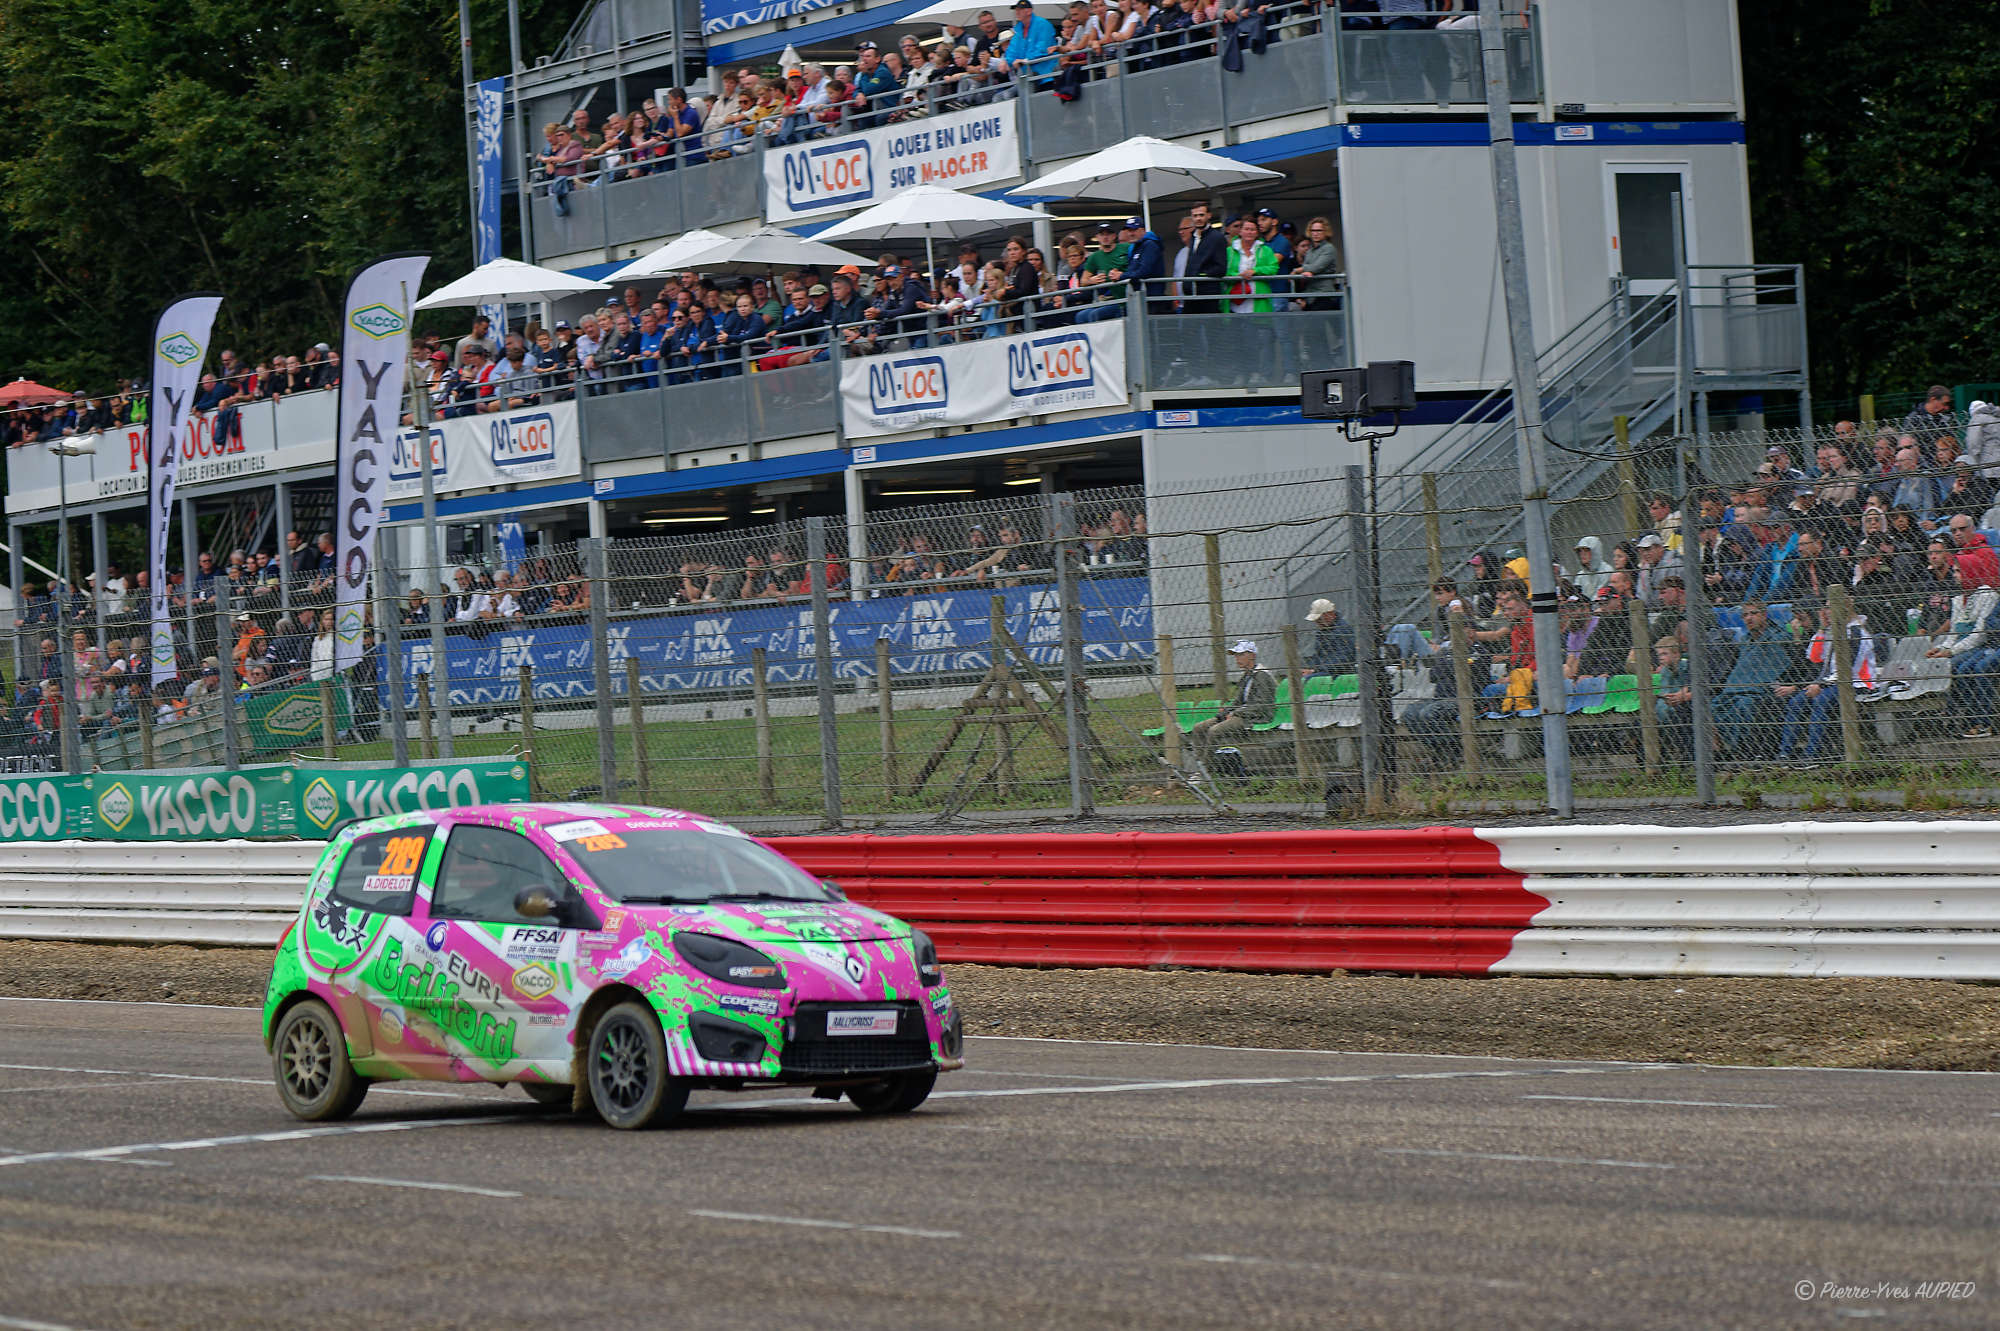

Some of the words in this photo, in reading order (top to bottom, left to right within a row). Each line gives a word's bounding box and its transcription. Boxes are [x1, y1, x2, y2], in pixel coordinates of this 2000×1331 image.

[888, 132, 930, 160] LOUEZ
[937, 128, 955, 149] EN
[960, 117, 1002, 145] LIGNE
[785, 149, 863, 195] M-LOC
[890, 166, 915, 188] SUR
[921, 151, 988, 184] M-LOC.FR
[359, 315, 400, 329] YACCO
[1008, 341, 1083, 382] M-LOC
[869, 362, 938, 401] M-LOC
[490, 418, 549, 454] M-LOC
[99, 477, 139, 496] LOCATION
[345, 359, 393, 589] YACCO
[0, 780, 61, 838] CCO
[140, 775, 256, 836] YACCO
[346, 768, 481, 818] YACCO
[378, 836, 426, 875] 289
[576, 834, 628, 852] 289
[513, 928, 560, 944] FFSA
[449, 953, 505, 1010] EURL
[518, 975, 552, 988] YACCO
[720, 995, 778, 1010] COOPER
